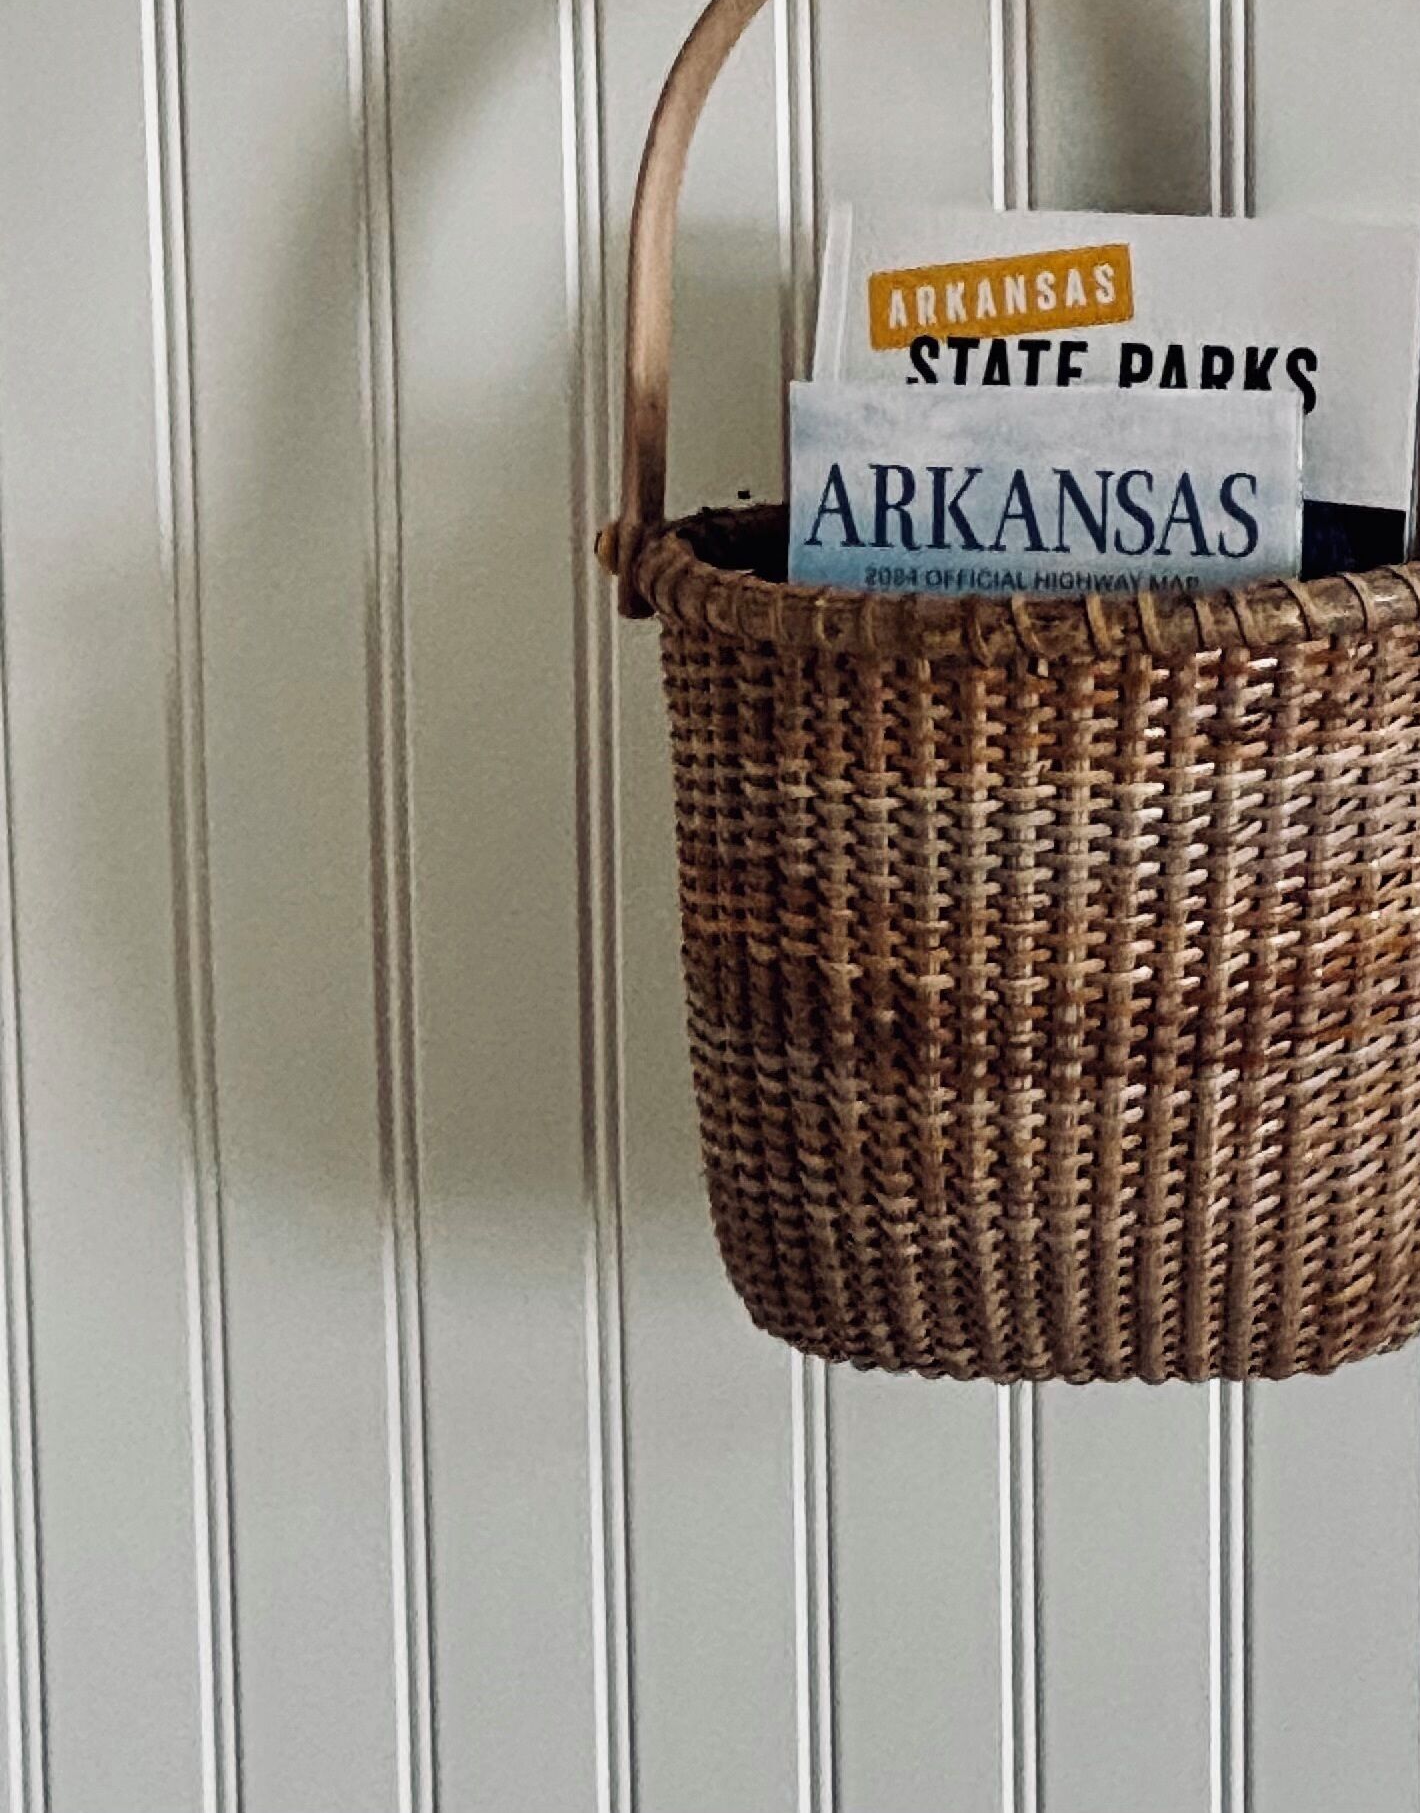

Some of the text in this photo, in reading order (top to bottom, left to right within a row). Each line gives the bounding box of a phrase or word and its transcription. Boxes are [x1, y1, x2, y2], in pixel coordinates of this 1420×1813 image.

[888, 262, 1116, 329] ARKANSAS
[905, 335, 1318, 416] STATE PARKS
[803, 462, 1258, 559] ARKANSAS
[925, 568, 1028, 591] OFFICIAL
[1034, 570, 1143, 591] HIGHWAY
[1149, 572, 1200, 591] MAP
